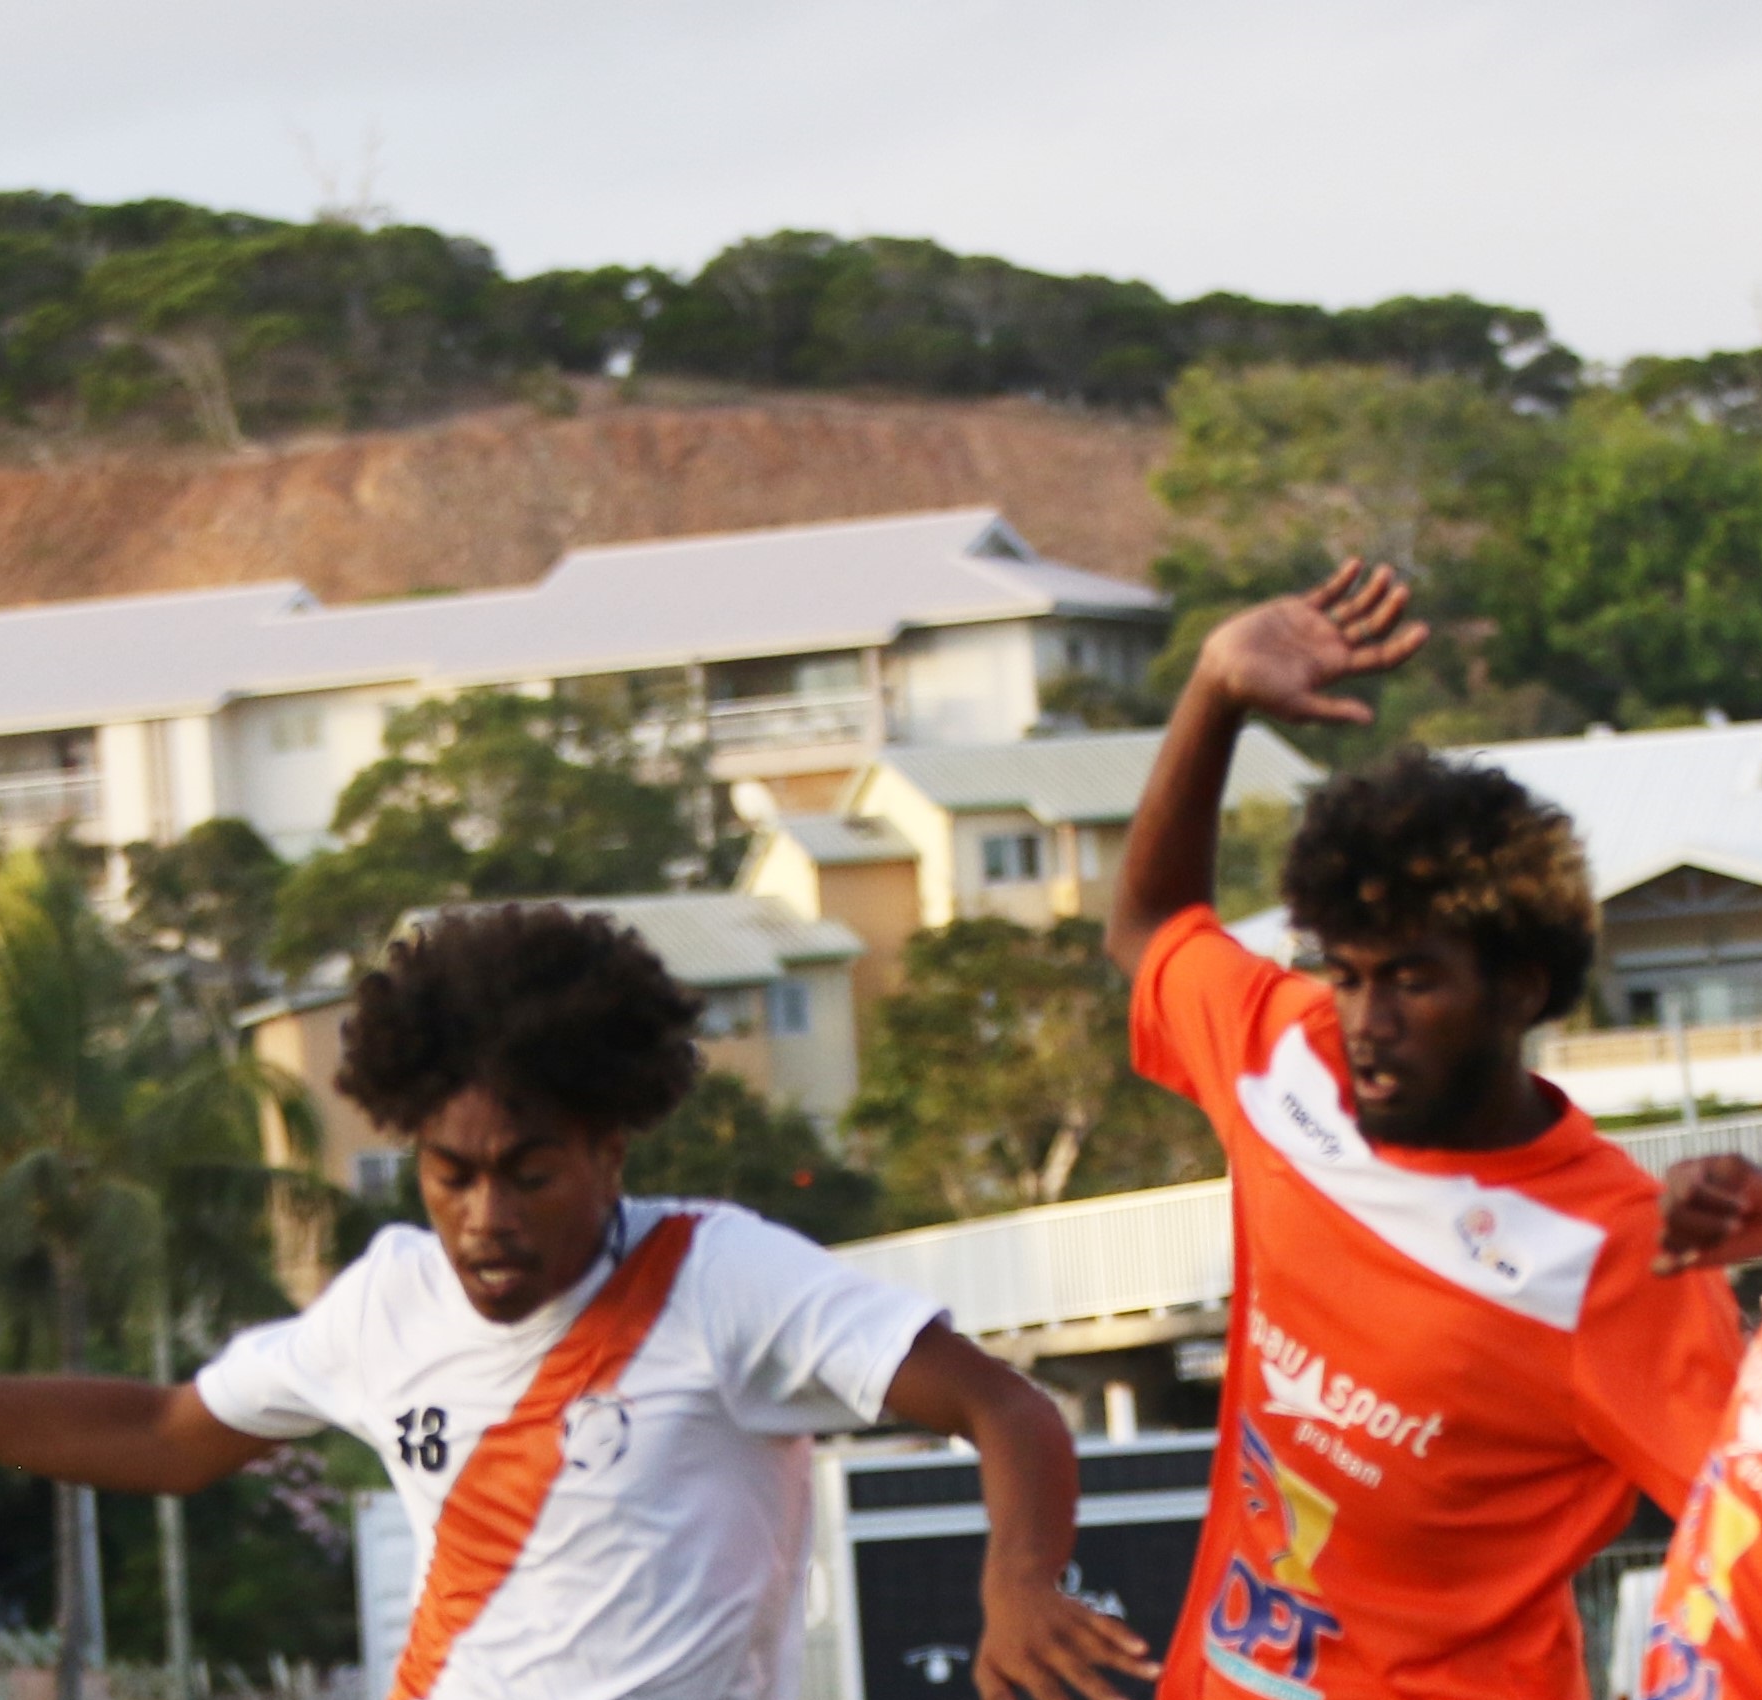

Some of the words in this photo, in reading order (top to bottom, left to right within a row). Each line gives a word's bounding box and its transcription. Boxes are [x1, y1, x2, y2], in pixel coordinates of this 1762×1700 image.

[396, 1406, 449, 1472] 13
[1325, 1373, 1444, 1458] sport
[1210, 1556, 1344, 1683] OPT
